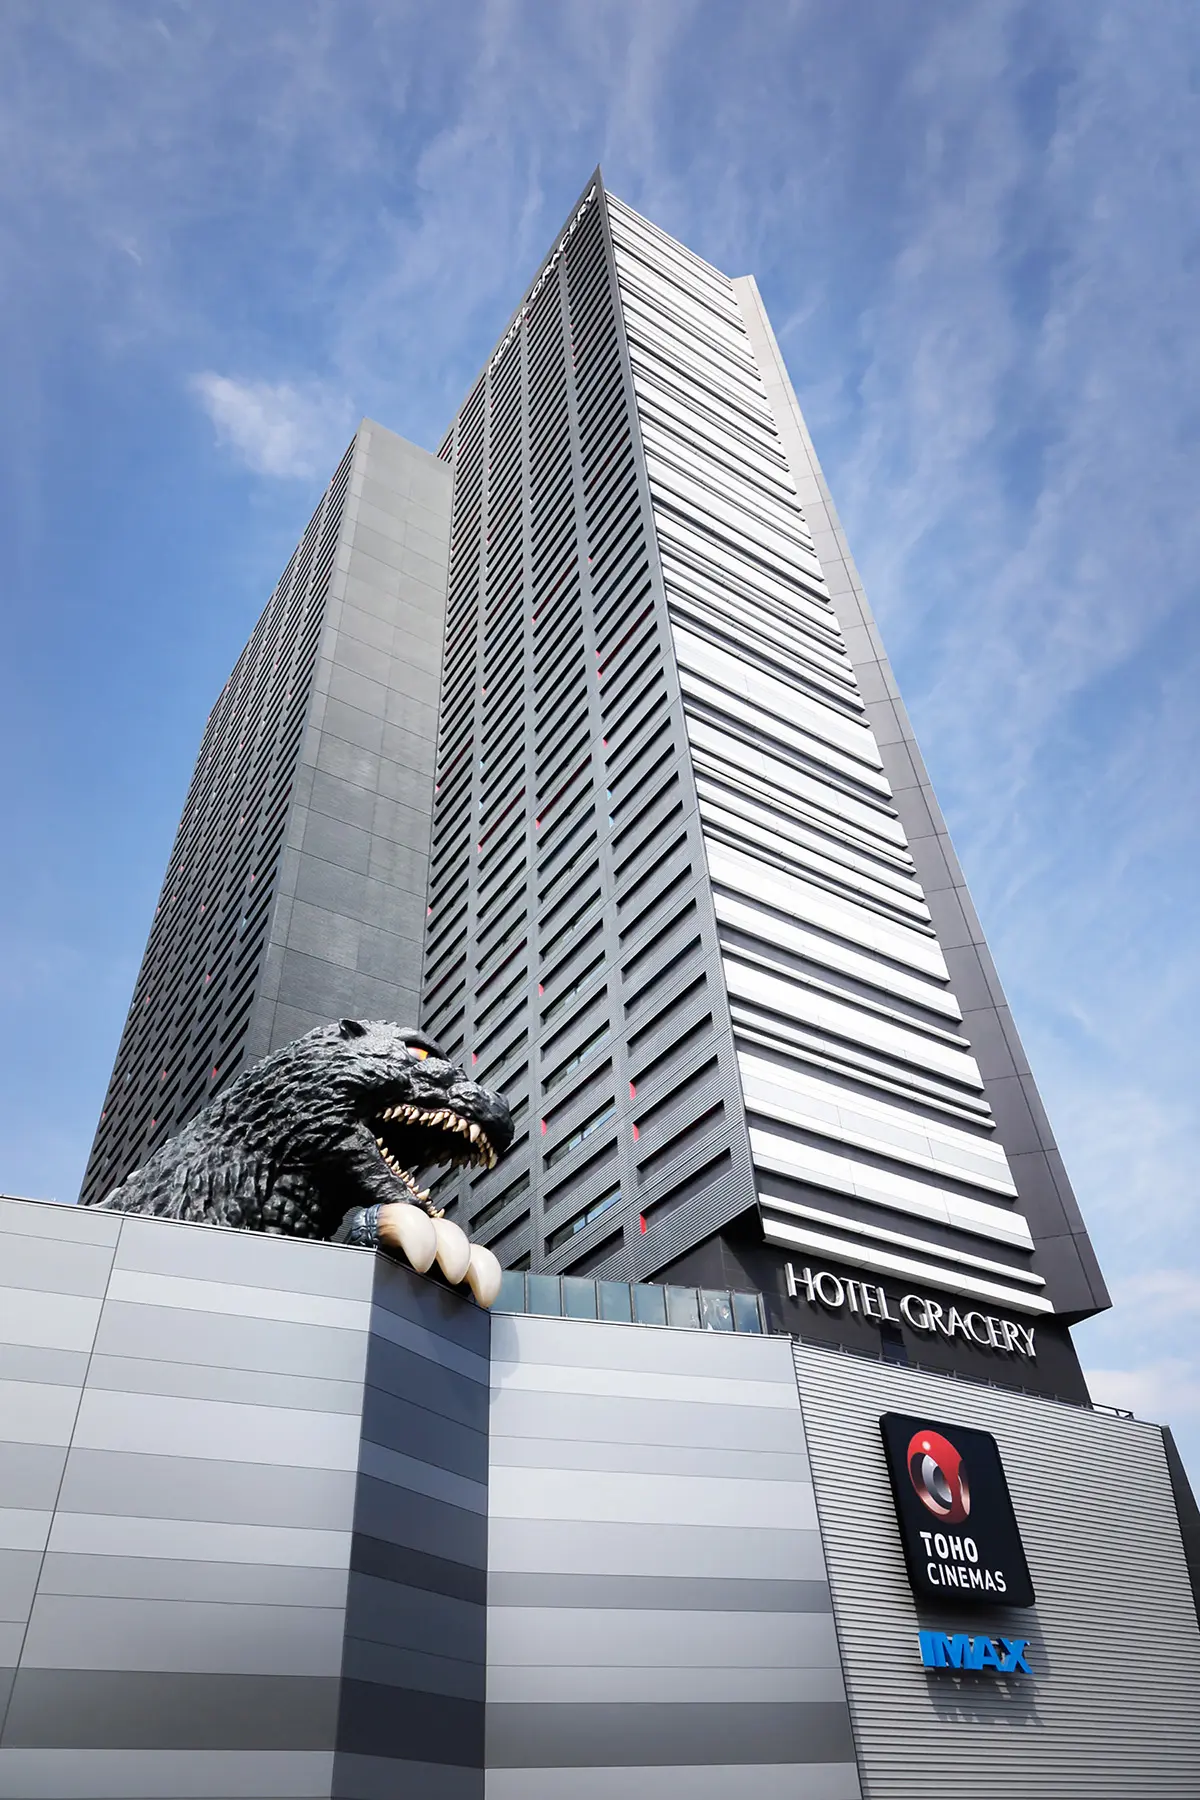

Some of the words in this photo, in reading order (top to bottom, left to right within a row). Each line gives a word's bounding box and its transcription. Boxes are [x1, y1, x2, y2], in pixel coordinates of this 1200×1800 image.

[784, 1262, 900, 1322] HOTEL
[899, 1294, 1036, 1357] GRACERY
[920, 1530, 979, 1563] TOHO
[927, 1563, 1007, 1593] CINEMAS
[918, 1630, 1034, 1674] IMAX
